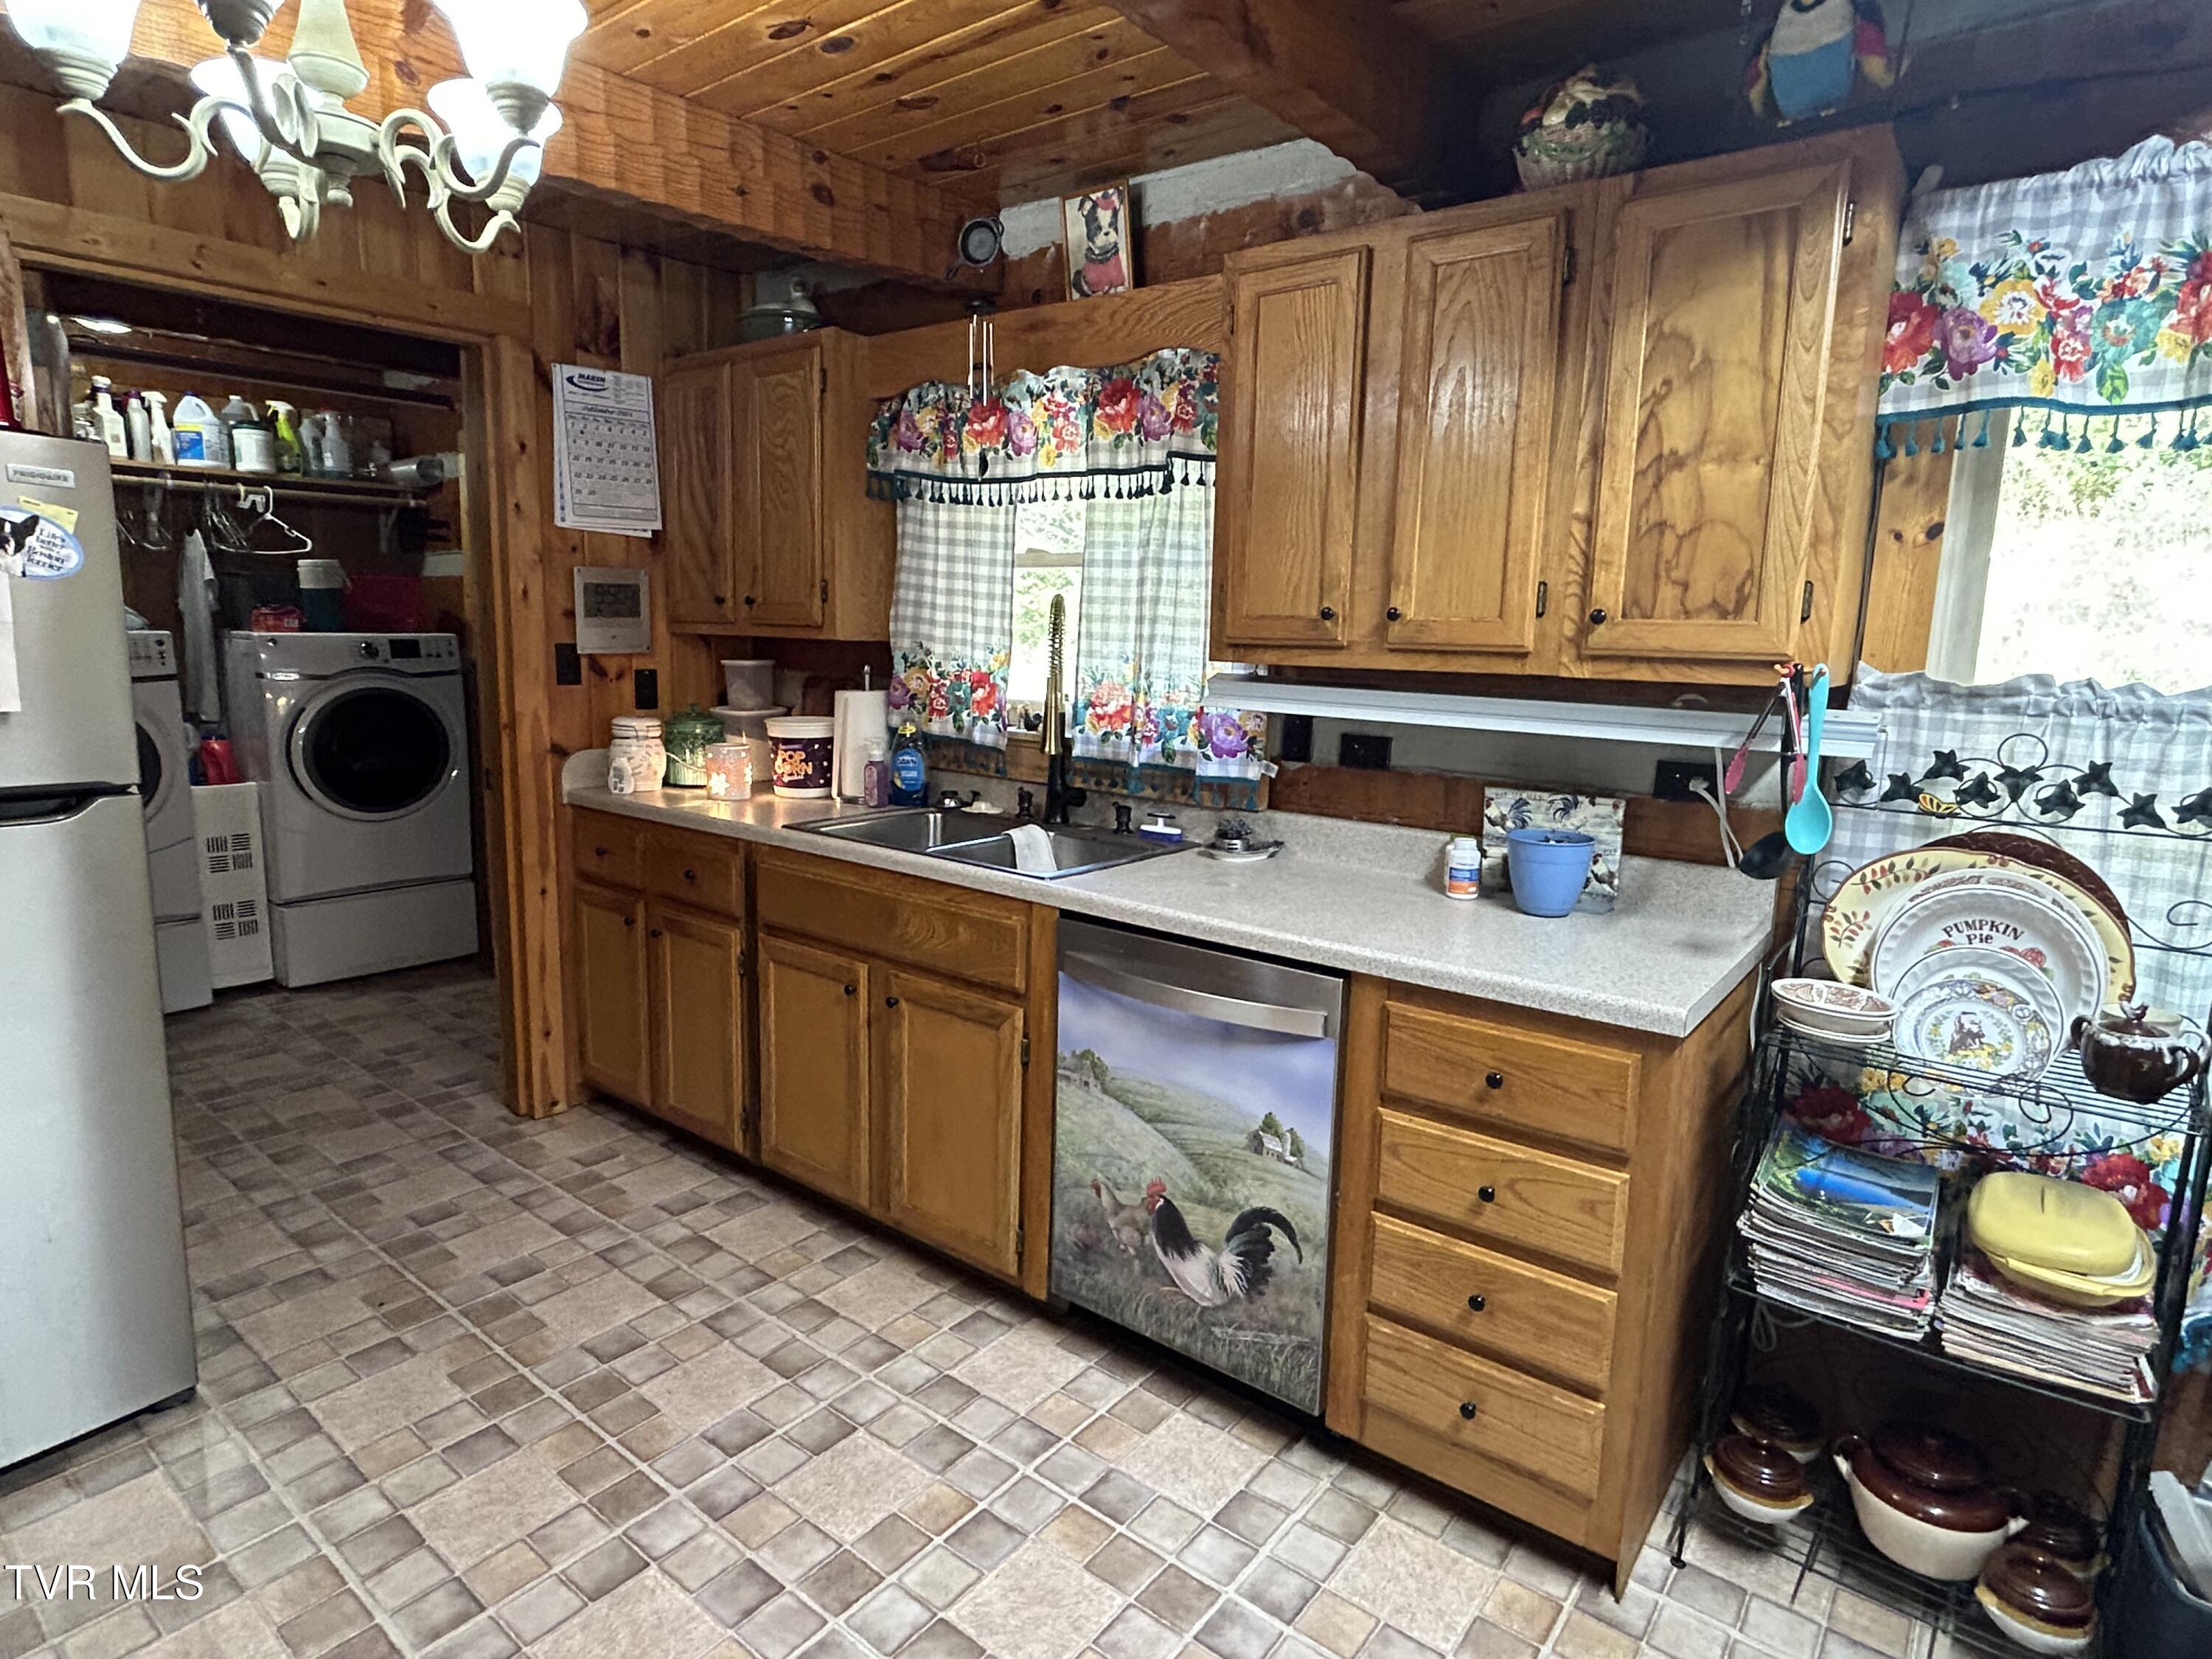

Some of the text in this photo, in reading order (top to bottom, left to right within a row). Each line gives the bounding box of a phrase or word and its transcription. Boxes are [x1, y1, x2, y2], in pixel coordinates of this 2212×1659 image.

[777, 750, 807, 763] POP
[775, 760, 813, 775] CORN
[1942, 919, 2025, 941] PUMPKIN
[1966, 933, 1994, 945] Pie
